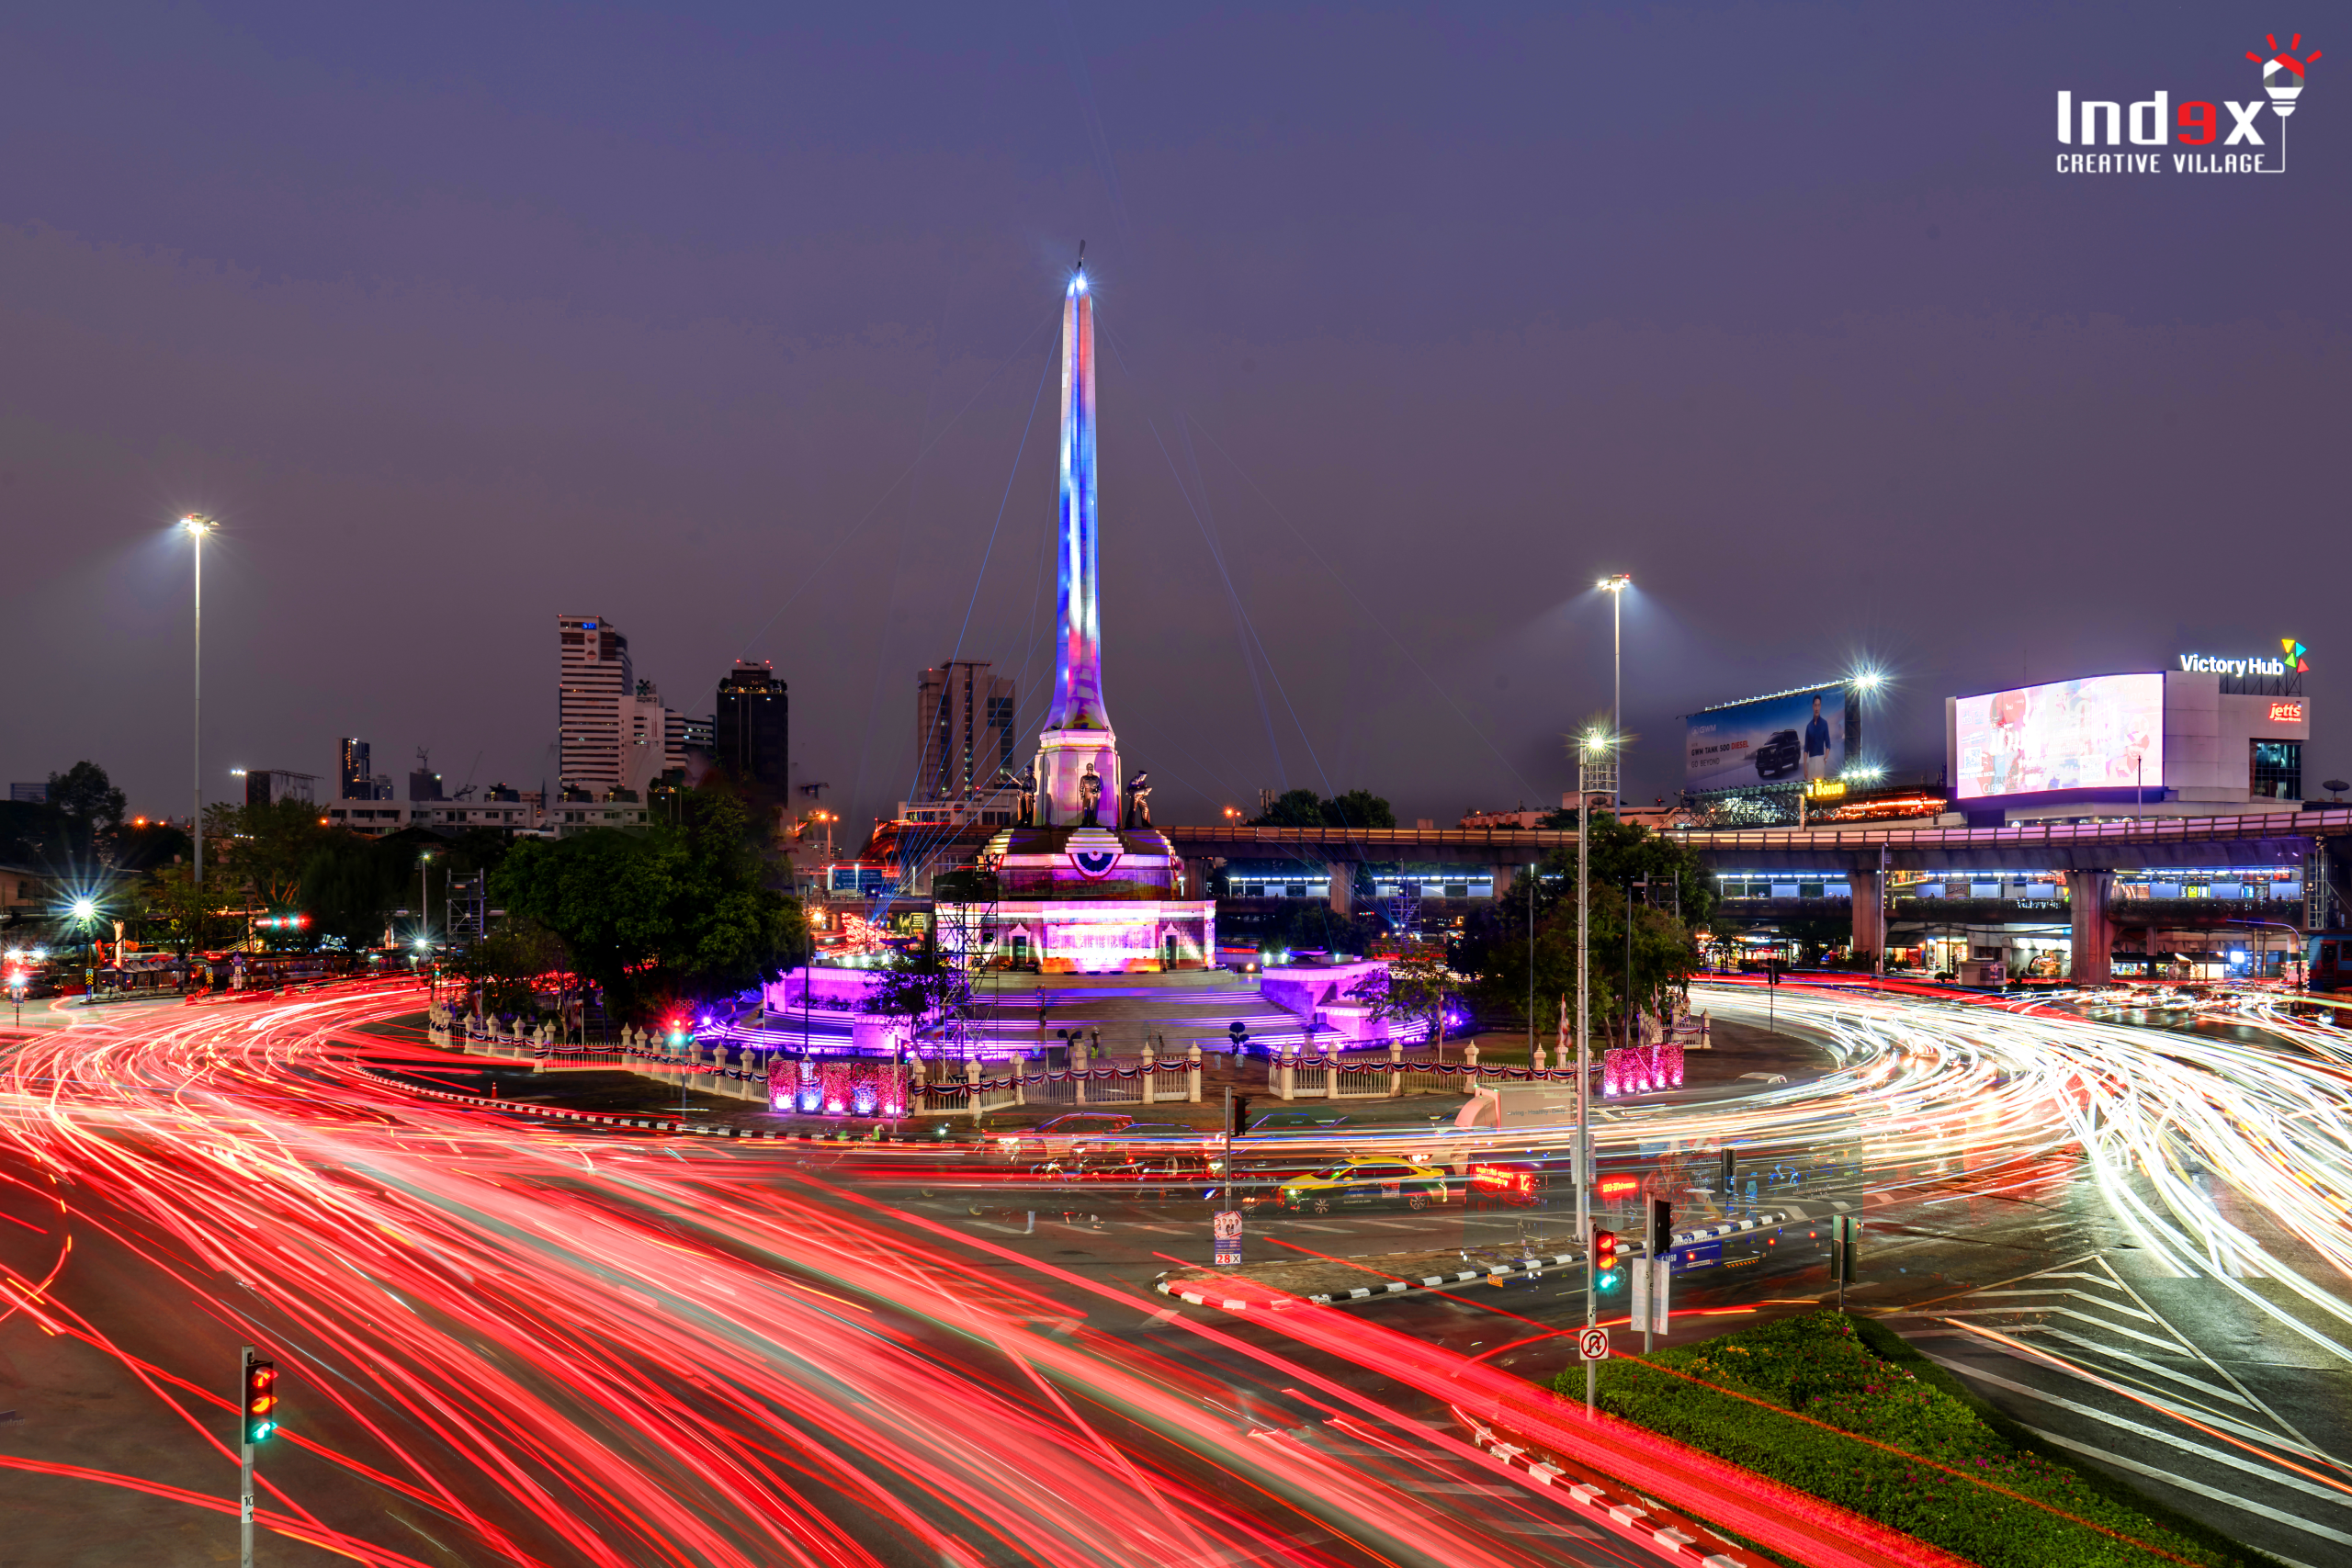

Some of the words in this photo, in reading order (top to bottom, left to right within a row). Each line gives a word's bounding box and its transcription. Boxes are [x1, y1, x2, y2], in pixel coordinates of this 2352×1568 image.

[2179, 652, 2247, 678] Victory
[2247, 657, 2286, 676] Hub
[2268, 703, 2301, 719] jetts
[1700, 724, 1717, 734] GWM
[1705, 745, 1719, 754] TANK
[1720, 743, 1730, 752] 500
[1731, 740, 1749, 750] DIESEL
[1691, 760, 1699, 768] GO
[1701, 757, 1721, 767] BEYOND
[1216, 1254, 1231, 1264] 28
